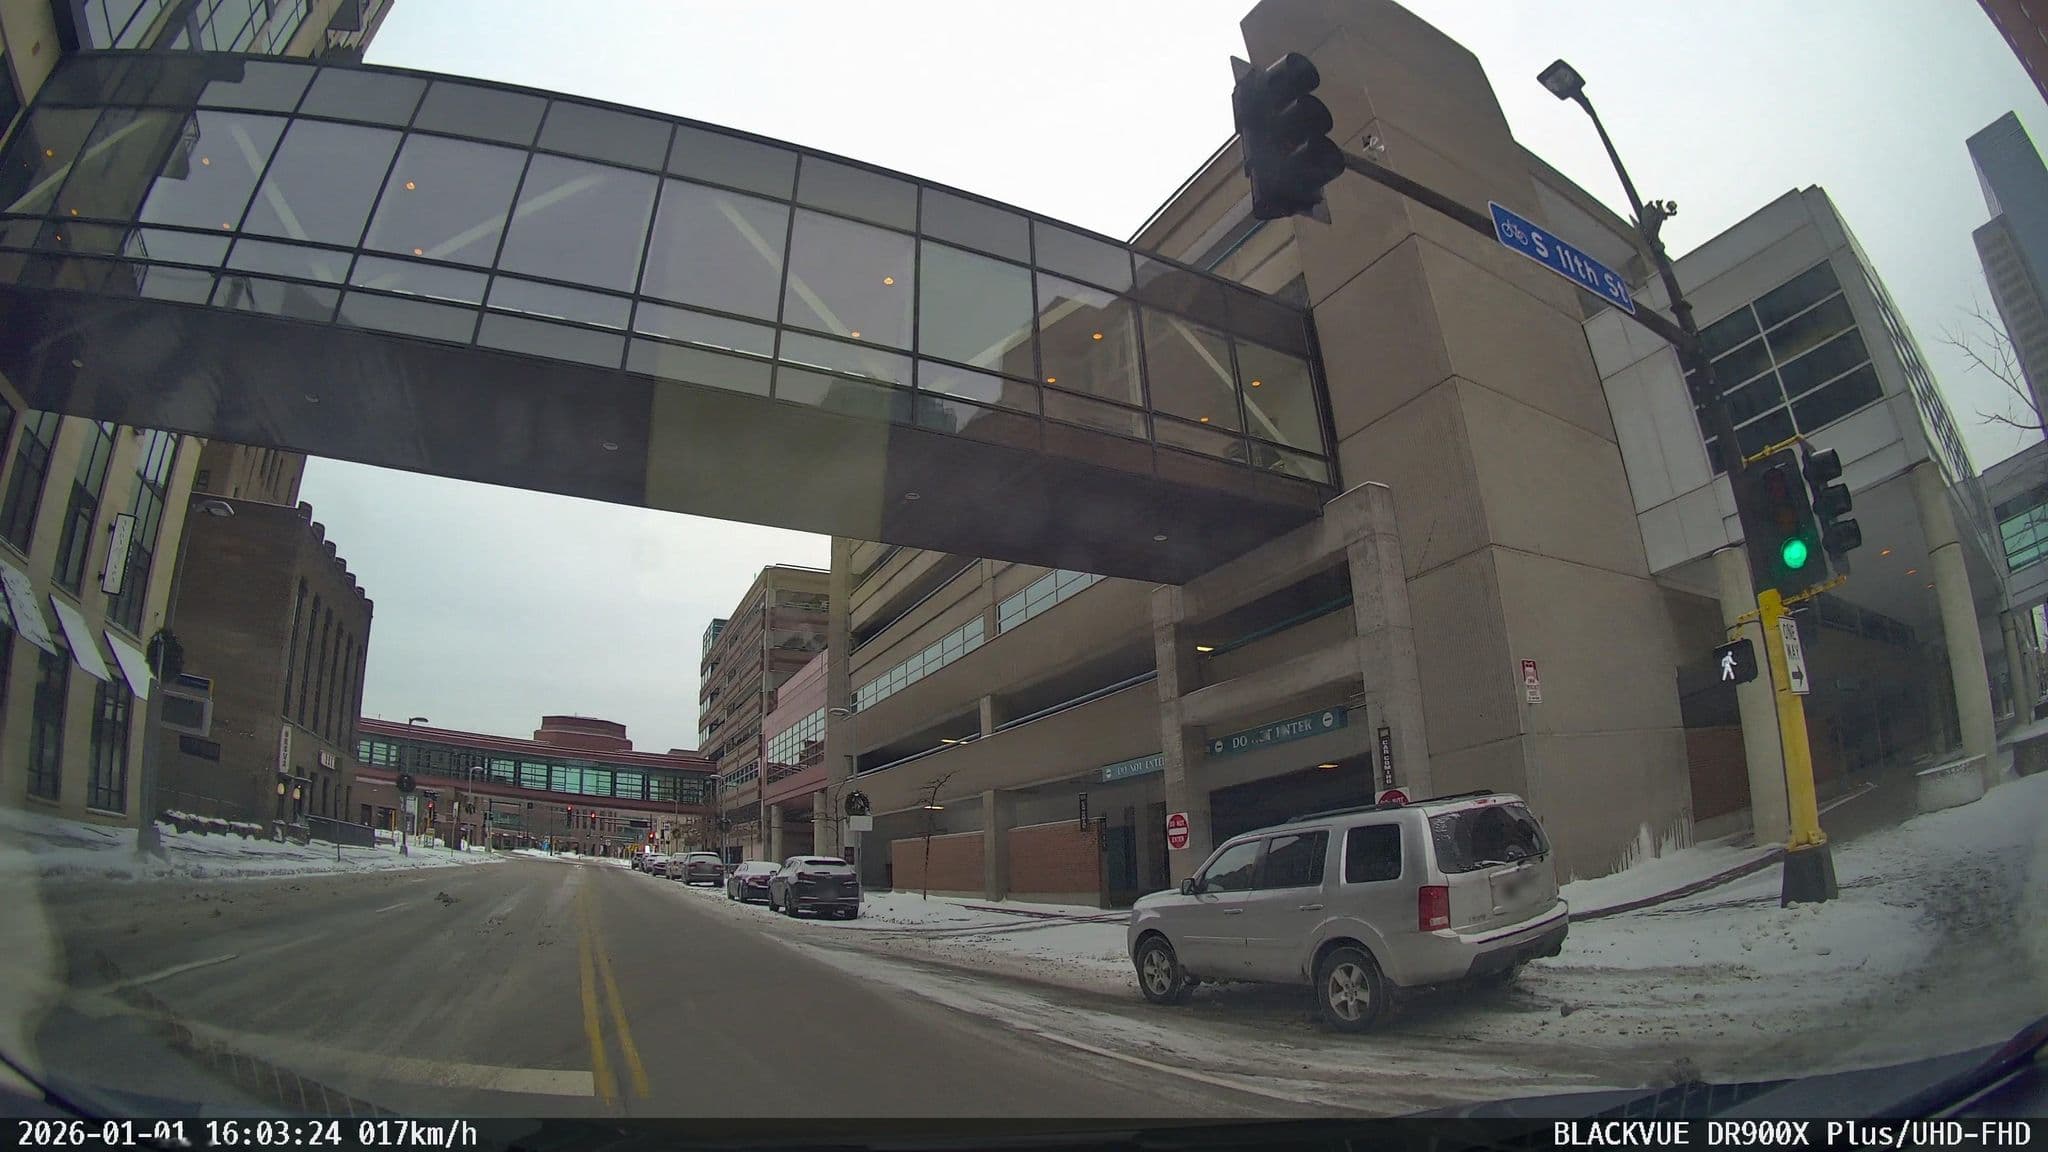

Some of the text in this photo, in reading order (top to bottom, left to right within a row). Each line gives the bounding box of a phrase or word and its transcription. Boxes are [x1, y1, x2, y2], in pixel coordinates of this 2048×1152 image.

[1531, 231, 1628, 303] S 11th St
[1782, 623, 1797, 640] ONE
[1785, 643, 1799, 657] WAY
[1232, 735, 1248, 749] DO
[1251, 728, 1273, 745] OT
[1145, 756, 1165, 769] ENTE
